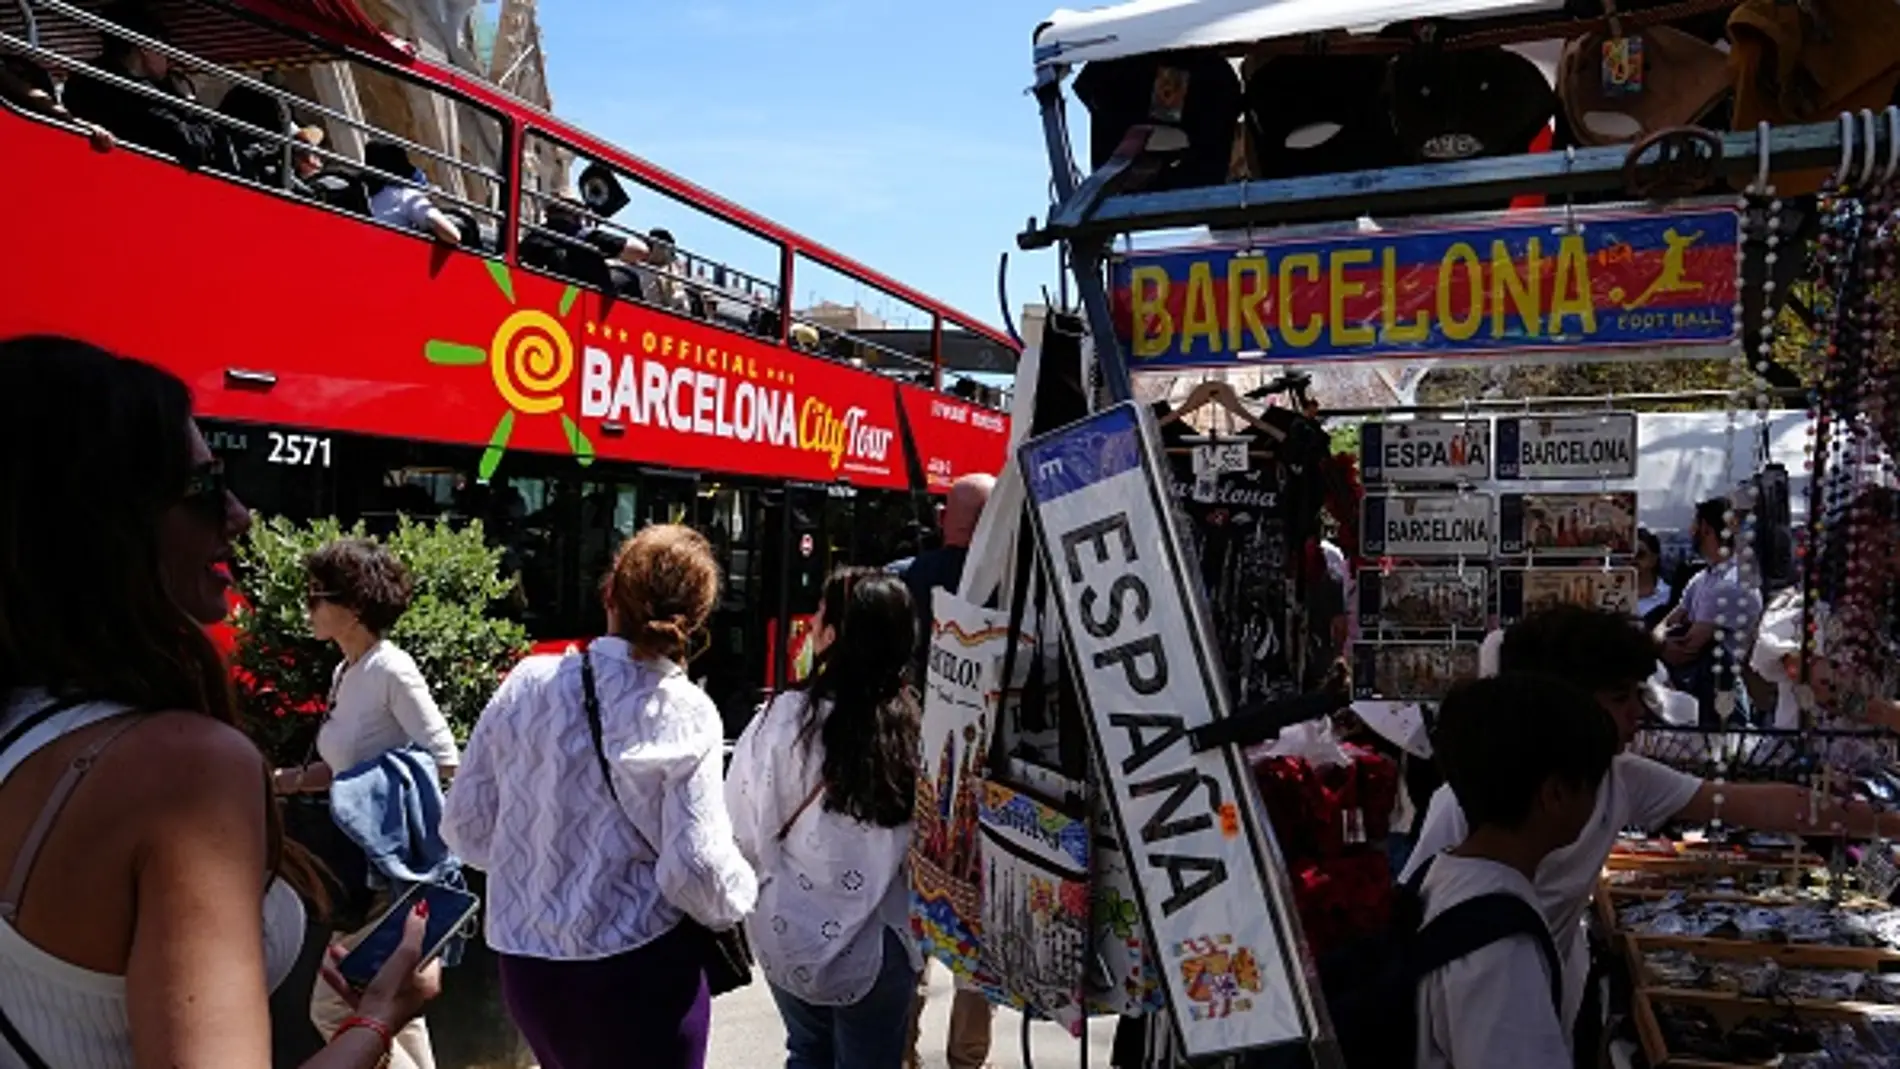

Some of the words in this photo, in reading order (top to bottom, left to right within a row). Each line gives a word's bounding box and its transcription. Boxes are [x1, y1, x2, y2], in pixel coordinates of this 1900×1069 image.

[1131, 235, 1598, 358] BARCELONA
[1617, 312, 1665, 330] FOOT
[1672, 308, 1723, 328] BALL
[641, 330, 758, 379] OFFICIAL
[581, 345, 798, 448] BARCELONA
[267, 431, 331, 468] 2571
[1522, 438, 1630, 466] BARCELONA
[1387, 519, 1489, 542] BARCELONA
[1060, 510, 1229, 919] ESPAÑA
